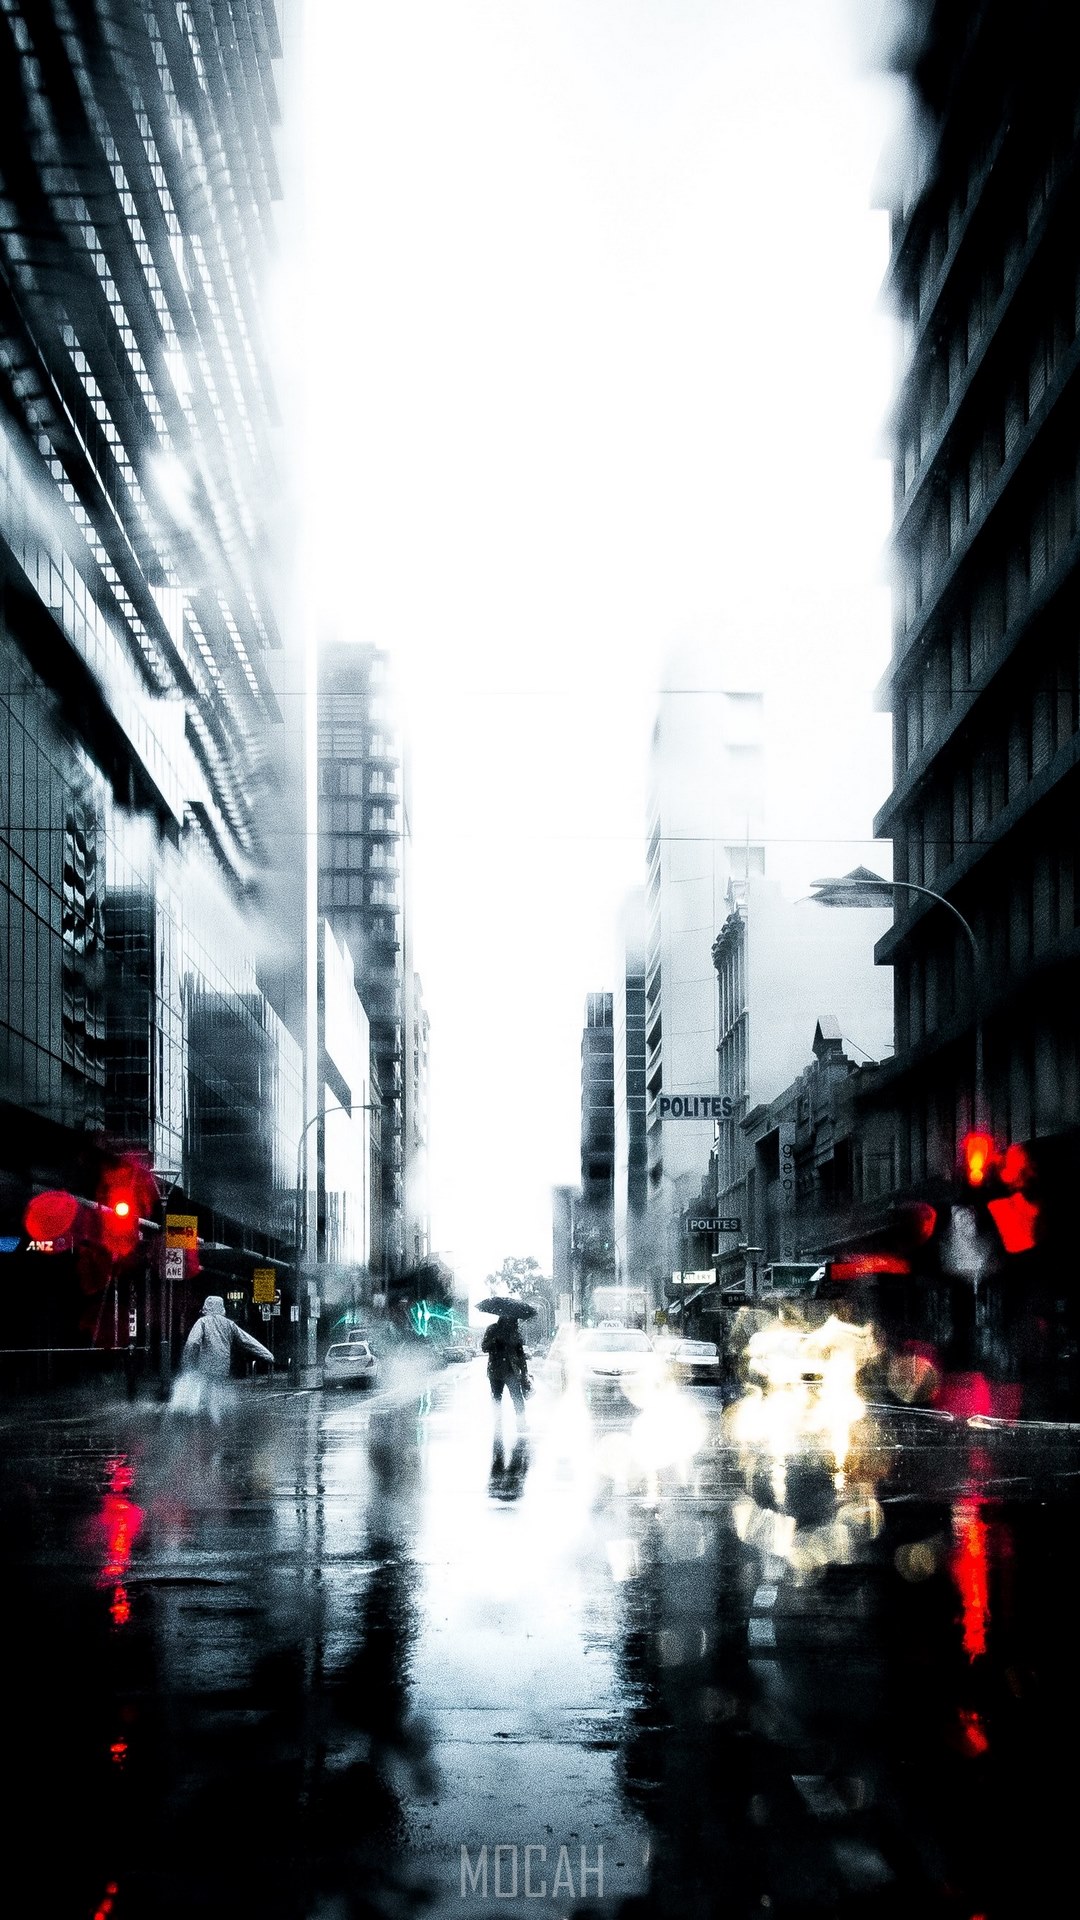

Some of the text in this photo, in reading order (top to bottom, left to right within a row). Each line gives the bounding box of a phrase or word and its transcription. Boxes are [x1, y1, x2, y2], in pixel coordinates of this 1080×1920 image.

[659, 1097, 733, 1118] POLITES
[782, 1143, 793, 1258] geors
[690, 1219, 738, 1231] POLITES
[25, 1240, 54, 1252] ANZ
[165, 1267, 182, 1276] ANE
